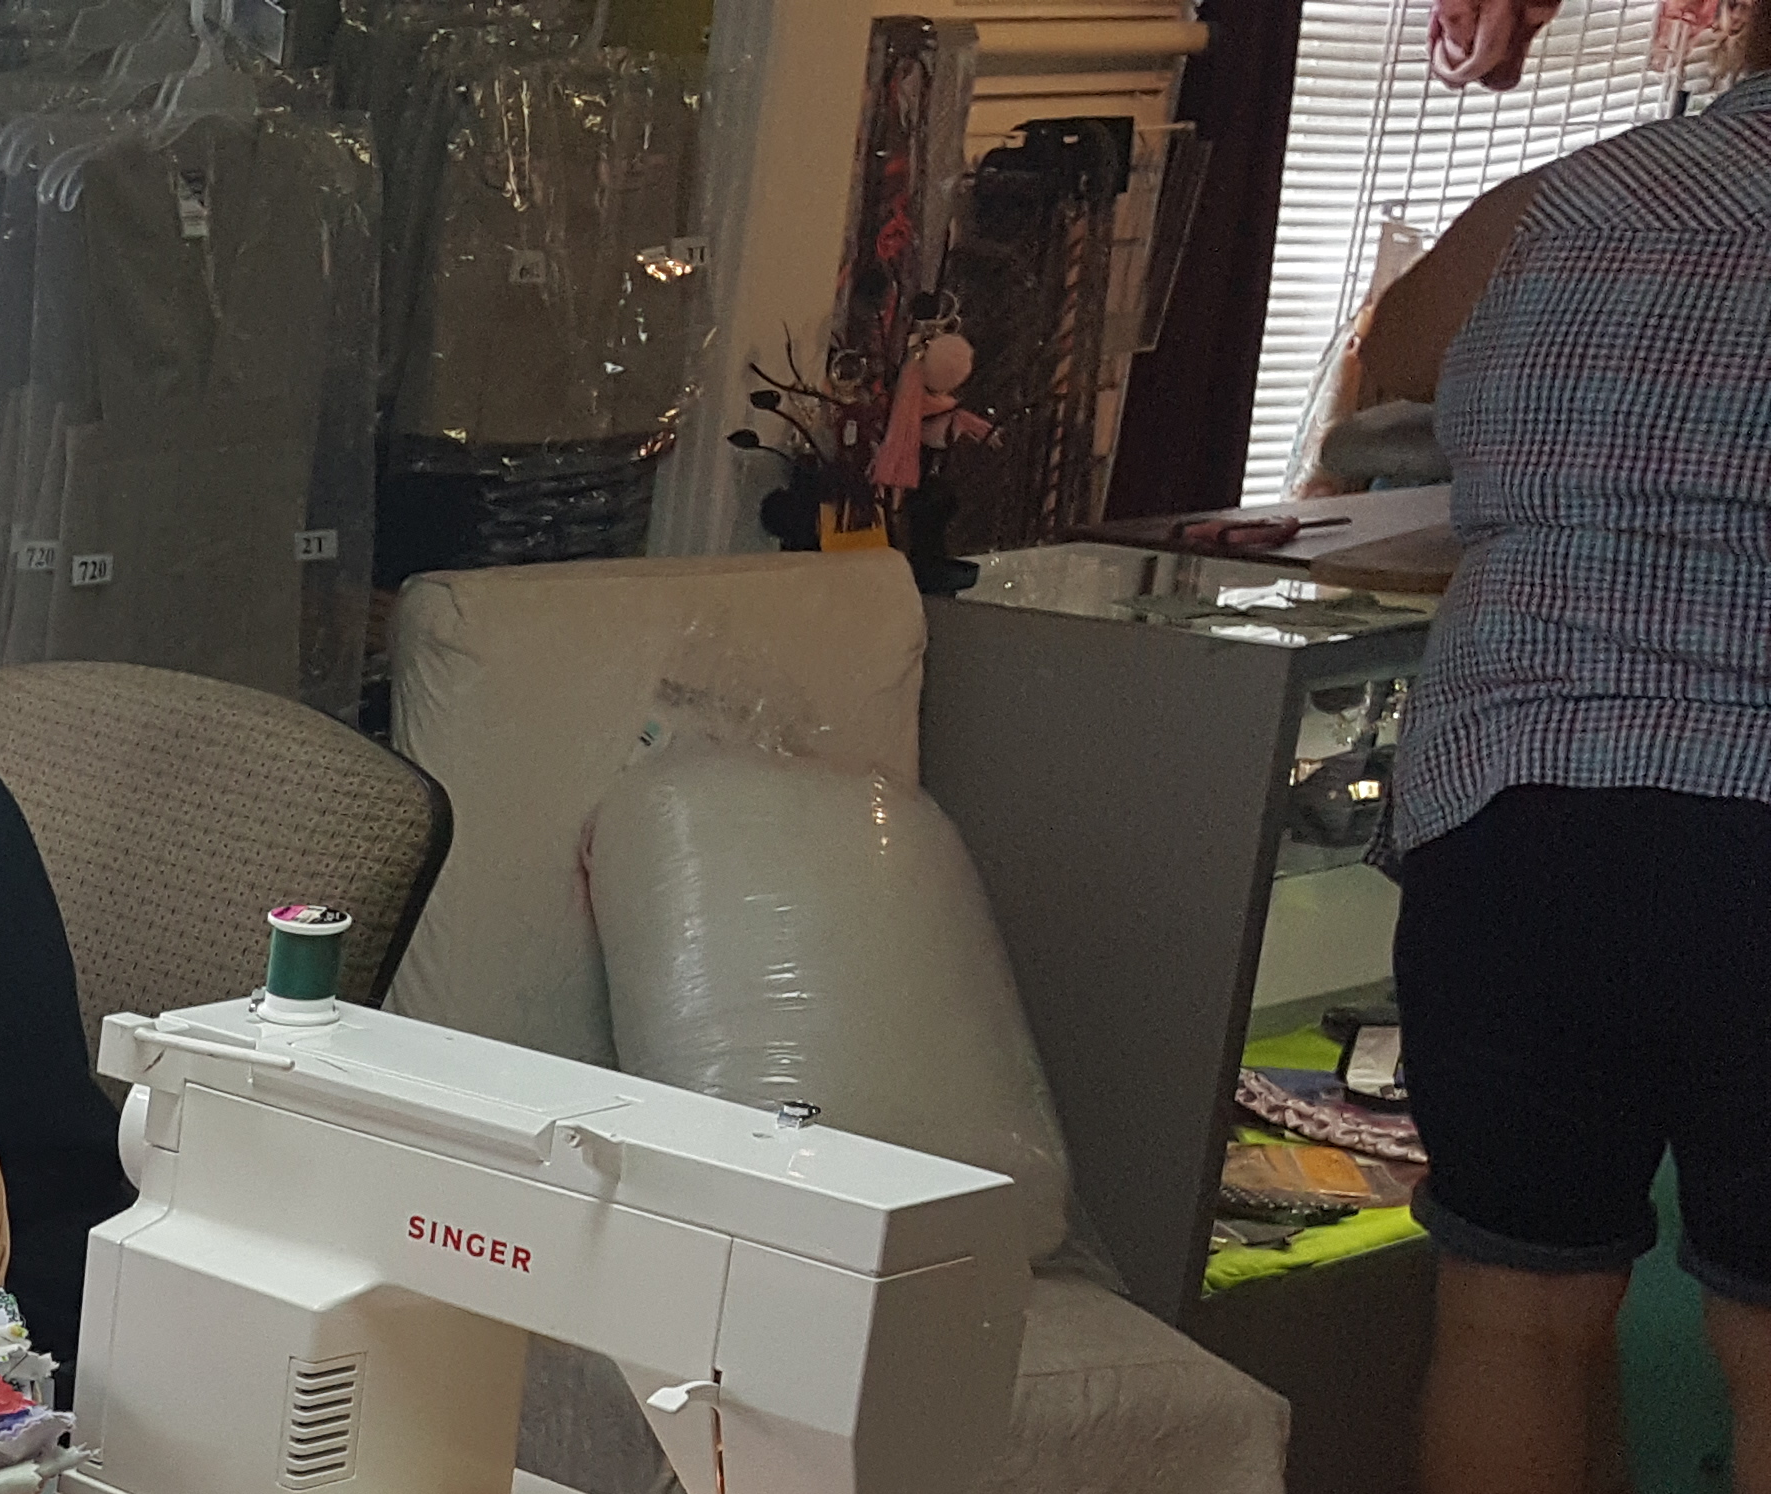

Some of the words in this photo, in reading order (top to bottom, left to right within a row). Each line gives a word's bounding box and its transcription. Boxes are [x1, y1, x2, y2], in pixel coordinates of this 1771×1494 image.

[26, 547, 55, 567] 720
[79, 560, 107, 581] 720
[407, 1215, 533, 1274] SINGER
